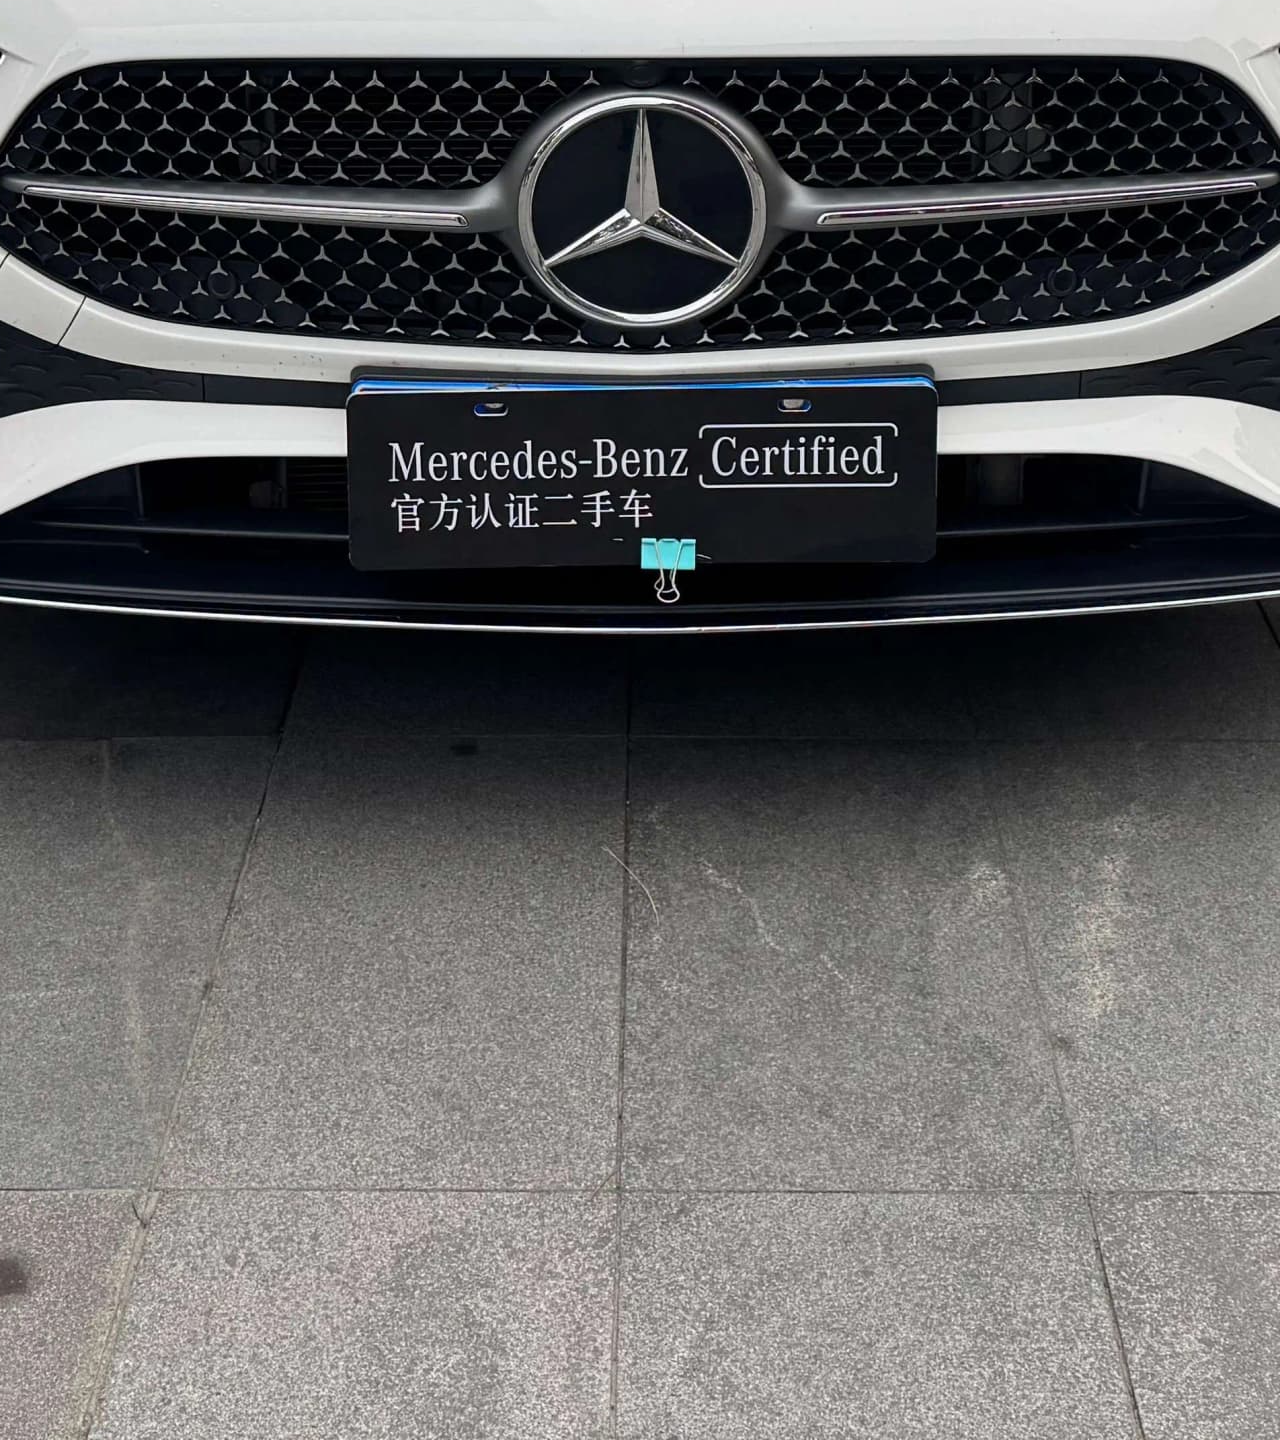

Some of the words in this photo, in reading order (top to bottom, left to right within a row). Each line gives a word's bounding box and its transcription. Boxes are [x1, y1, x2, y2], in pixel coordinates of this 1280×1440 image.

[388, 438, 689, 482] Mercedes-Benz
[711, 435, 885, 478] Certified
[390, 488, 653, 533] 官方认证二手车
